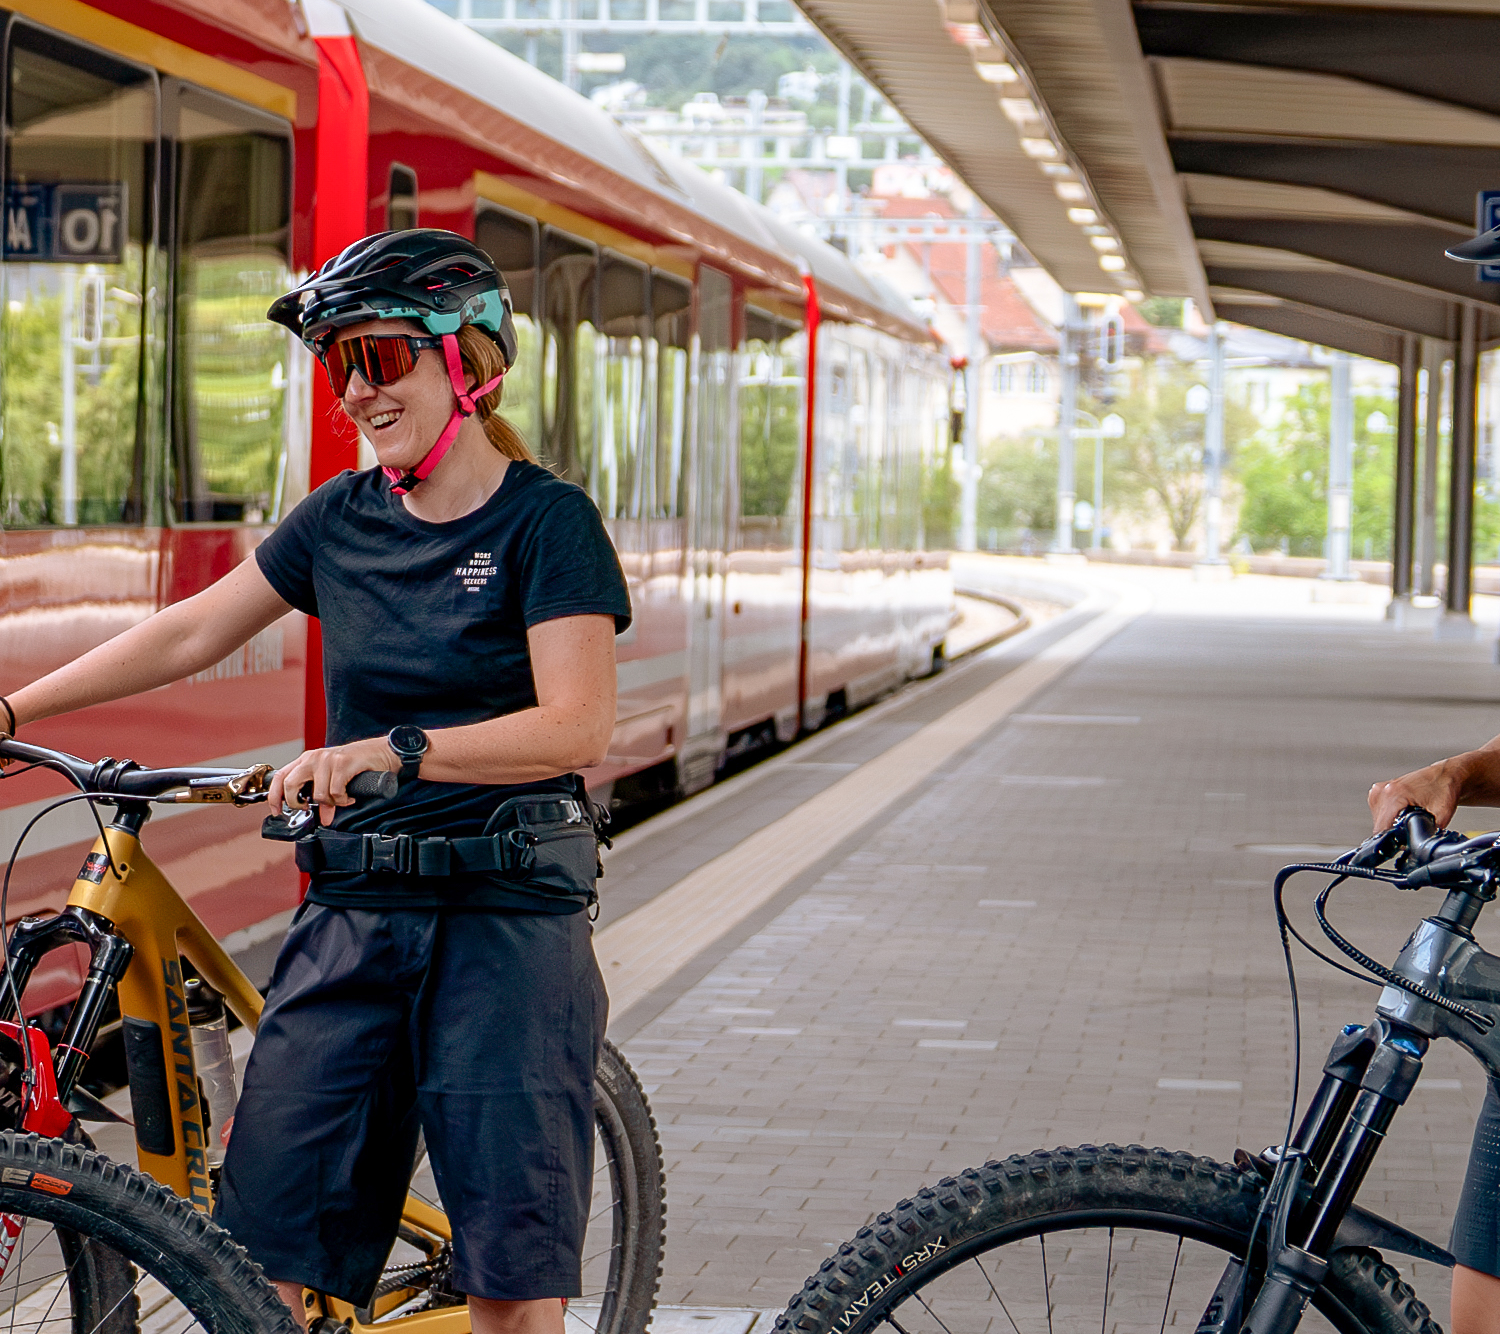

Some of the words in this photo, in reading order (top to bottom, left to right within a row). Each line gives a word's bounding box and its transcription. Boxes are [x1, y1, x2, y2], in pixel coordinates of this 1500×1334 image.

[455, 566, 498, 576] HAPPINESS
[162, 958, 197, 1112] SANTA
[182, 1121, 212, 1213] CRU
[902, 1235, 947, 1271] XR5
[839, 1273, 897, 1327] TEAM
